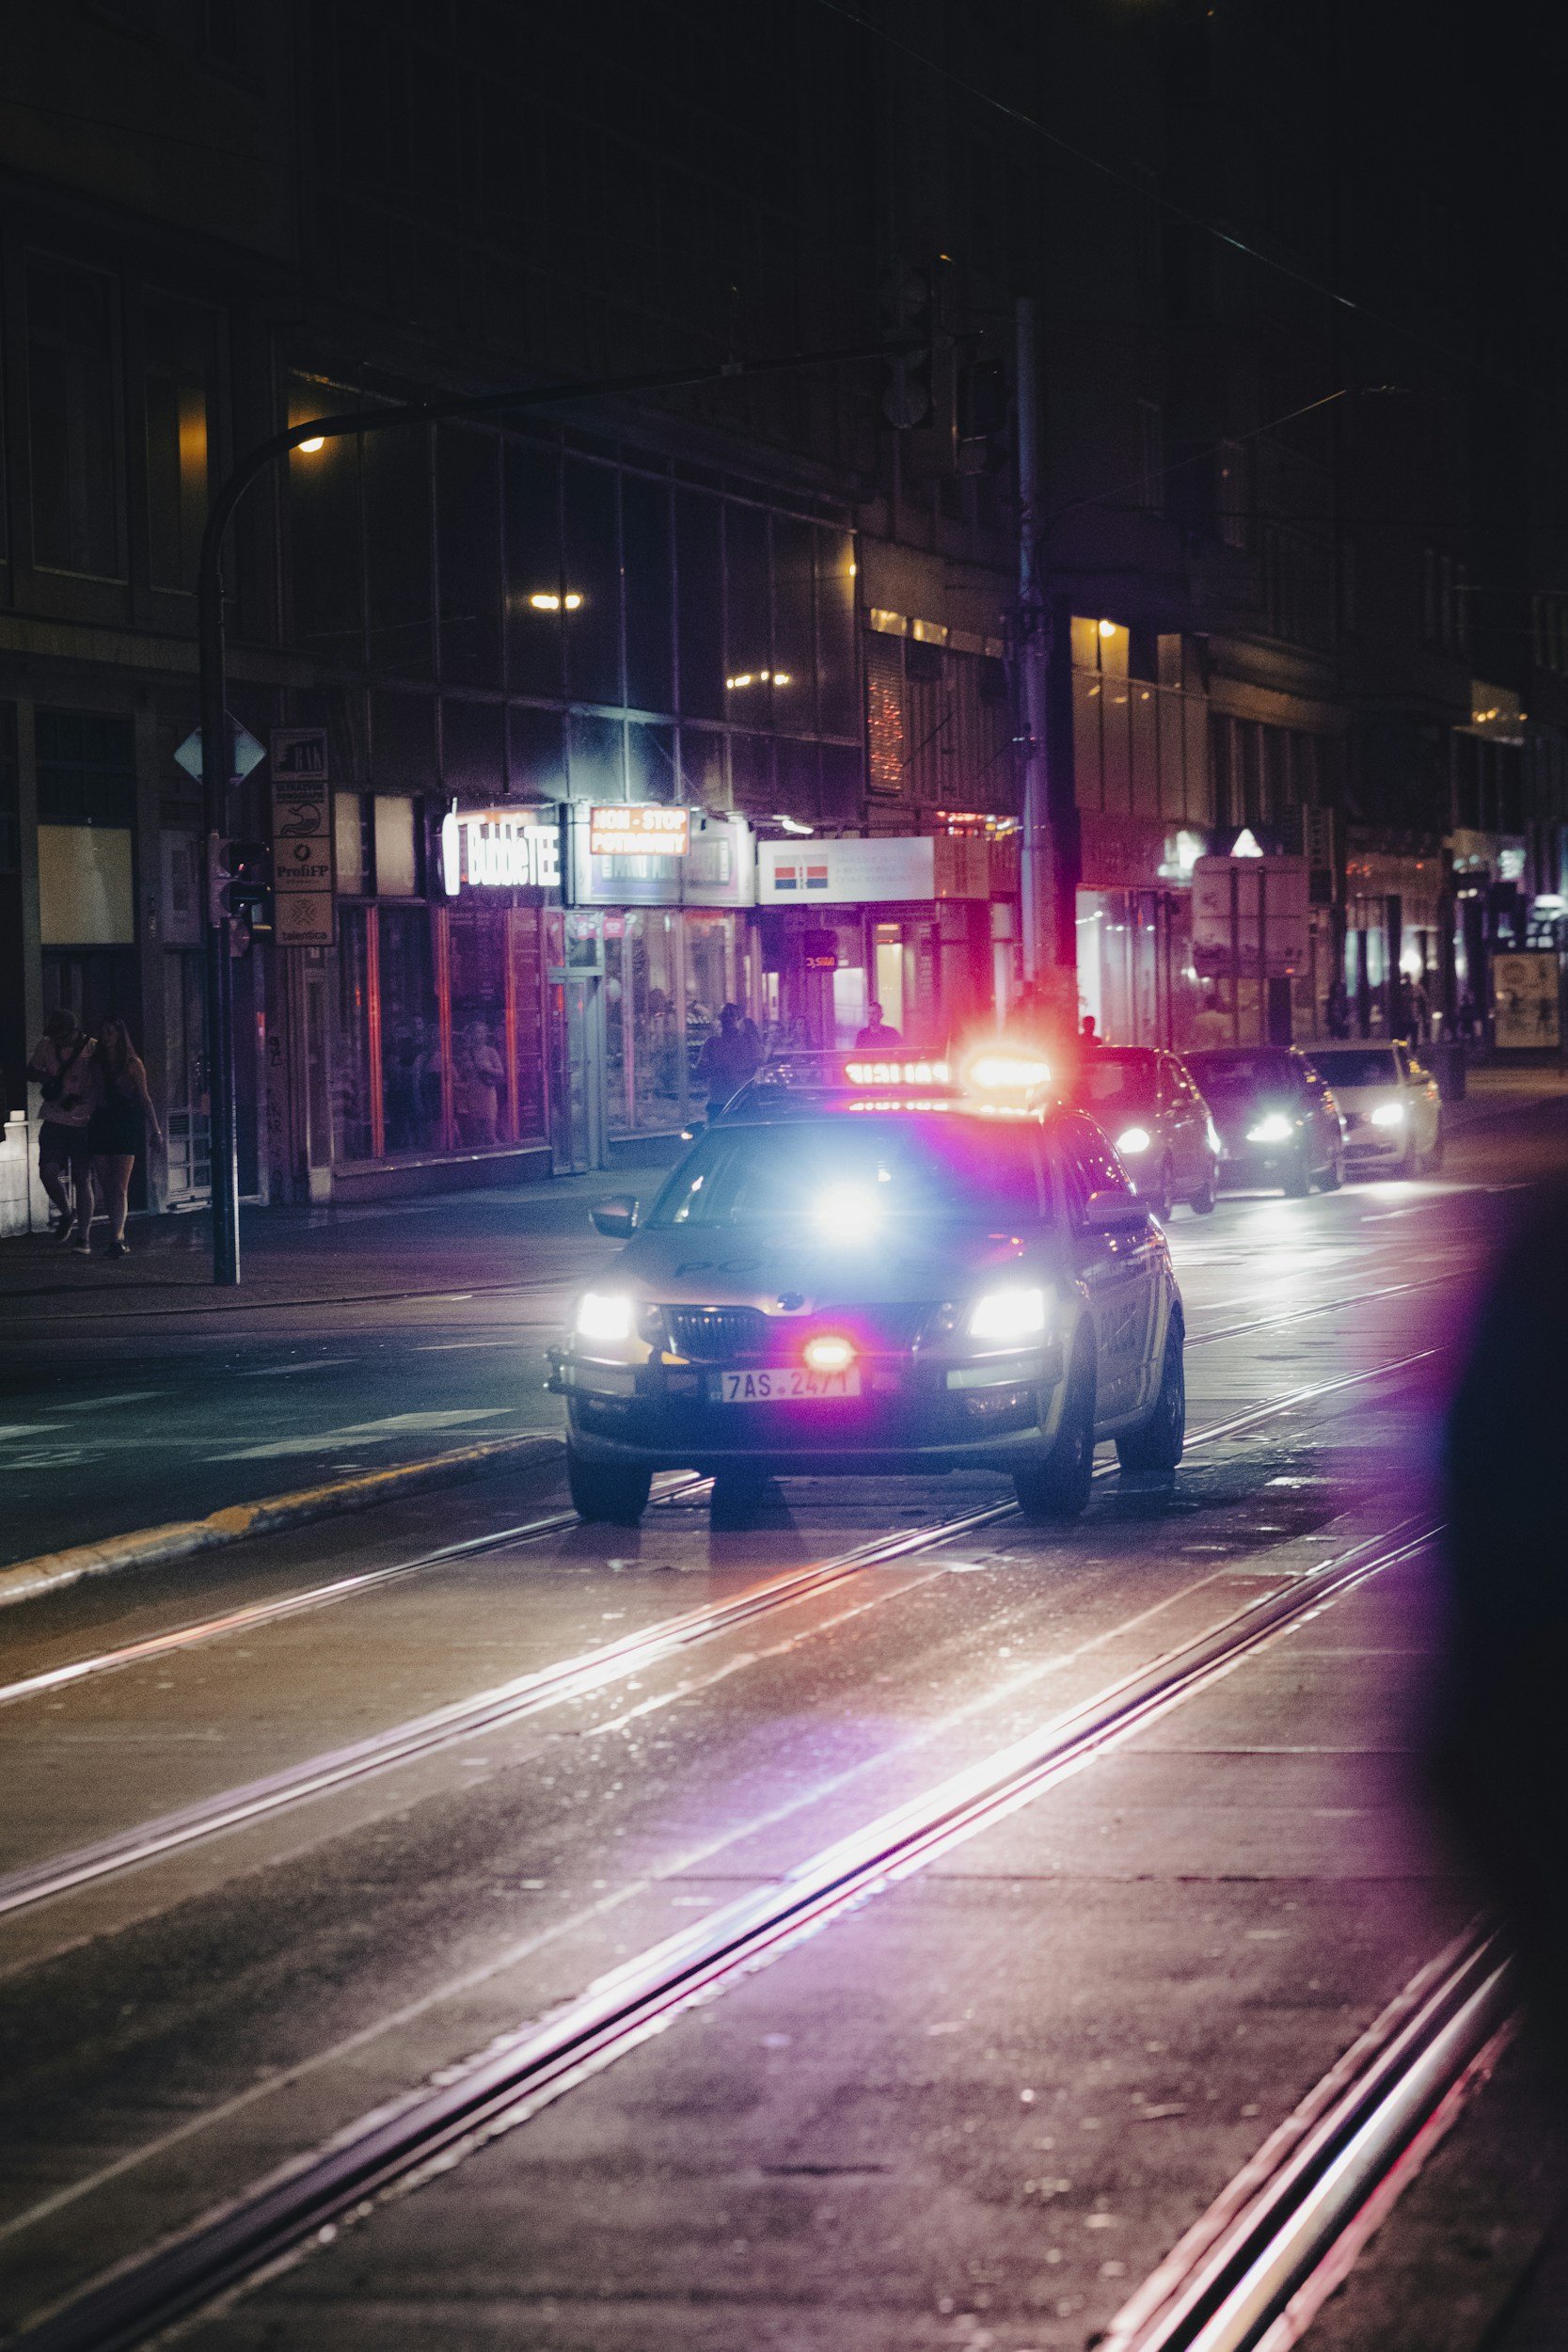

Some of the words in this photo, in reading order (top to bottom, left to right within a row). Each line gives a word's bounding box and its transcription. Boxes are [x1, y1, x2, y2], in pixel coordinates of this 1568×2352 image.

[642, 810, 687, 830] STOP
[277, 864, 328, 878] ProfiFP
[728, 1374, 771, 1399] 7AS
